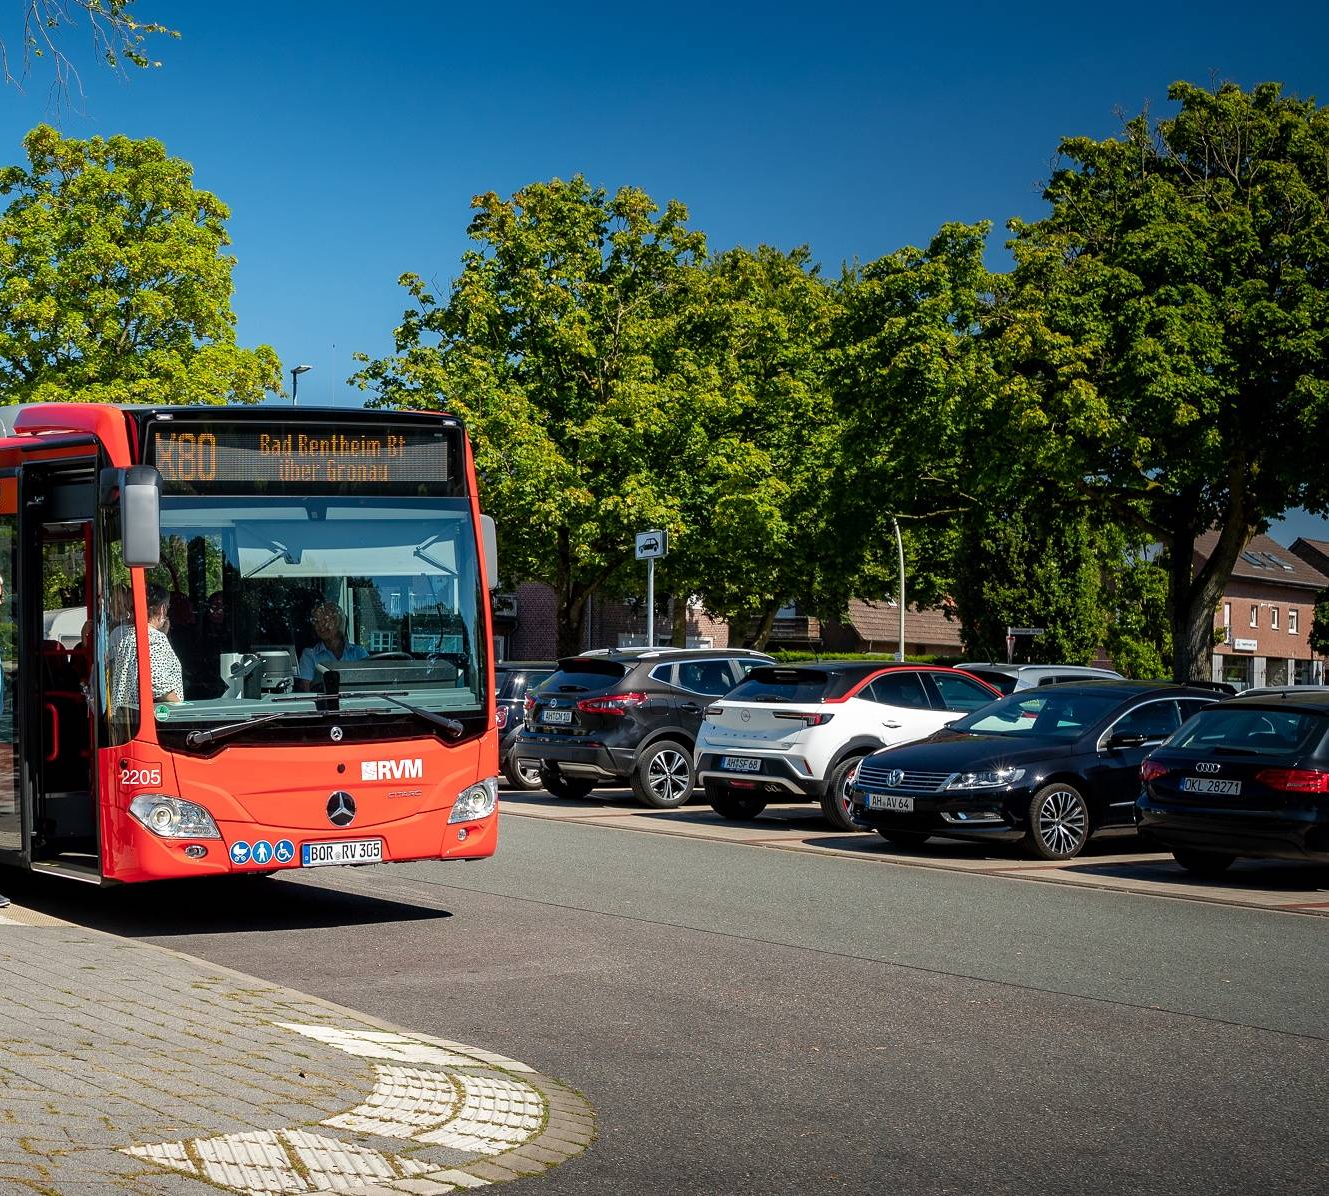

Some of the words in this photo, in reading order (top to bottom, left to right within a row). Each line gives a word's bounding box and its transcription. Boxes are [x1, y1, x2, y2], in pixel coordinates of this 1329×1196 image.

[260, 433, 292, 457] Bad
[155, 432, 216, 481] X80
[121, 769, 161, 785] 2205
[377, 758, 423, 780] RVM
[1207, 780, 1239, 794] 28271
[872, 795, 881, 806] AH
[886, 797, 897, 808] AV
[898, 798, 909, 809] 64
[311, 846, 333, 861] BOR
[342, 844, 357, 860] RV
[359, 842, 380, 858] 305
